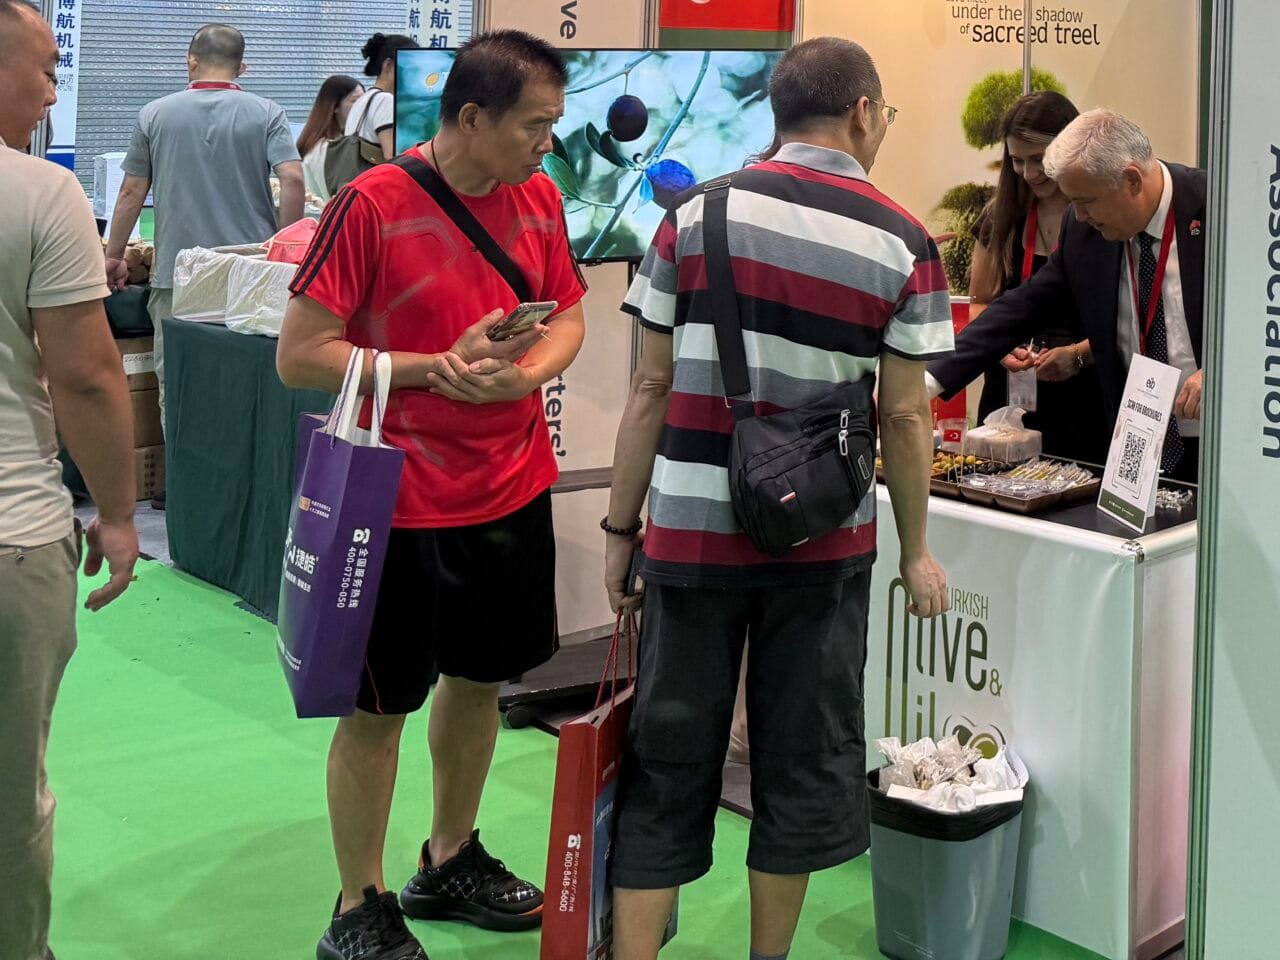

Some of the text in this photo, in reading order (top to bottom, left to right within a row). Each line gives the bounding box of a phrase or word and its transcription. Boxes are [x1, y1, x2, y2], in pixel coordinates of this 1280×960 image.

[952, 3, 1083, 23] under the shadow
[960, 23, 971, 35] of
[949, 586, 989, 621] URKISH
